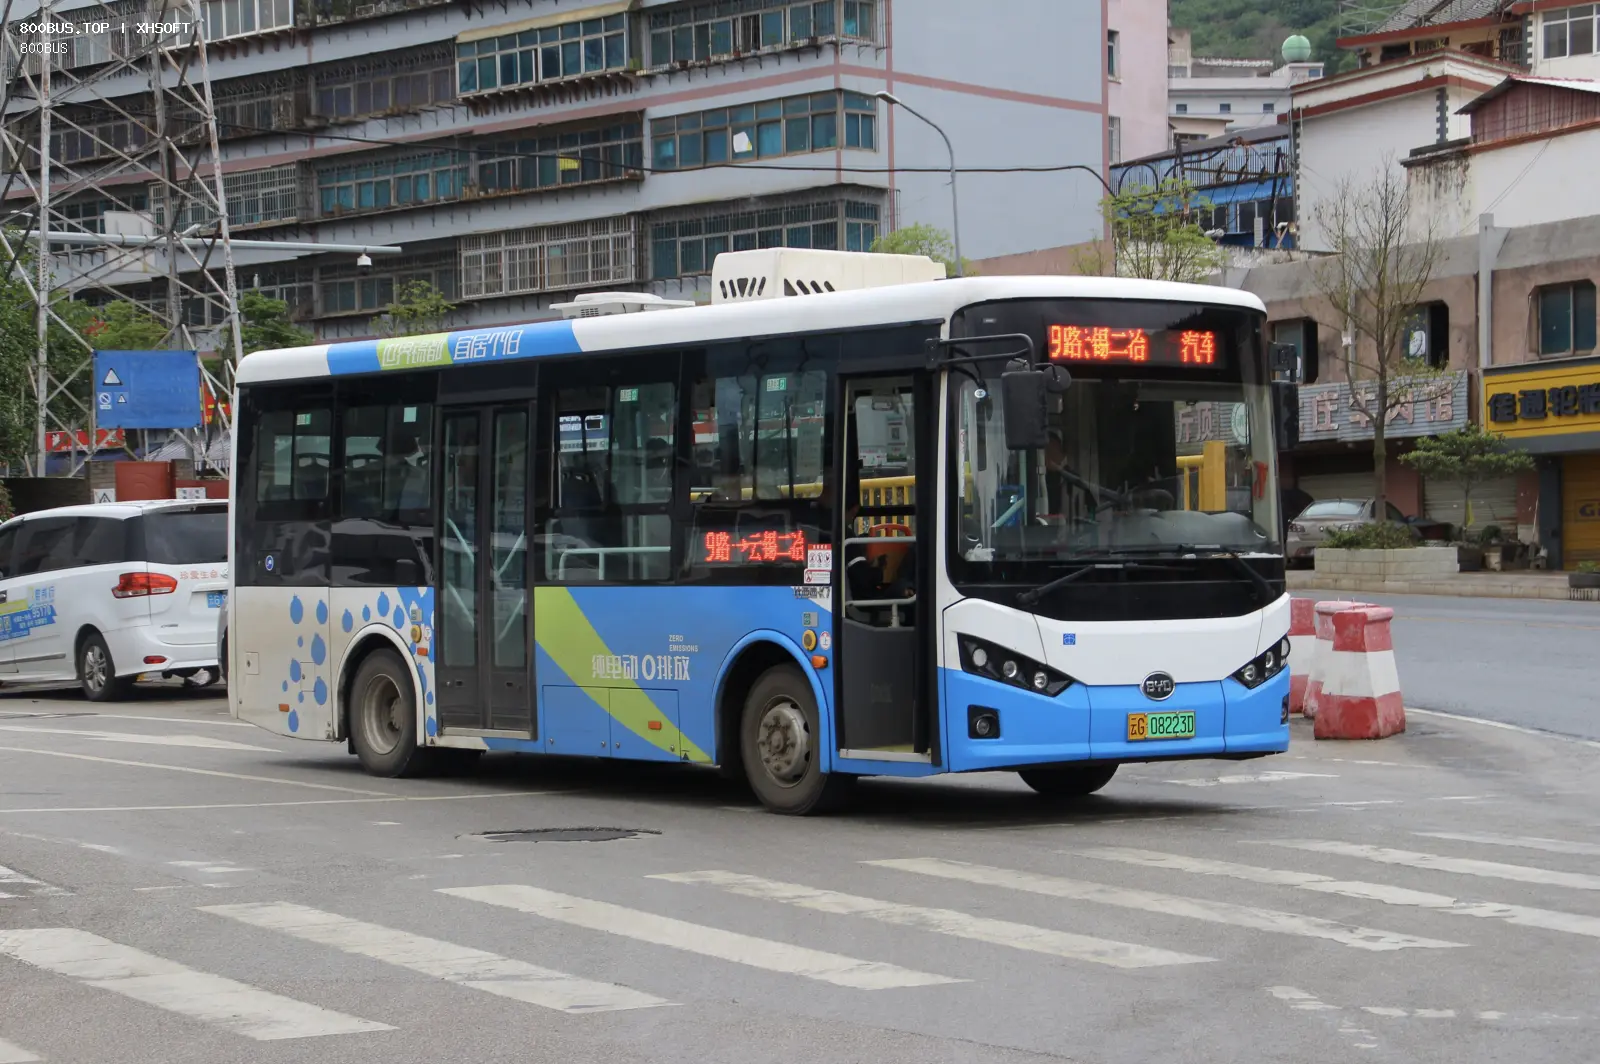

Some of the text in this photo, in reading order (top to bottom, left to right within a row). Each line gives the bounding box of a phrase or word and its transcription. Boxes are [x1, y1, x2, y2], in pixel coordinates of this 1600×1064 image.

[1181, 330, 1215, 363] 汽车
[1299, 378, 1453, 434] 庄牛肉馆
[1487, 383, 1600, 423] 佳通轮胎
[1145, 680, 1172, 692] BYD
